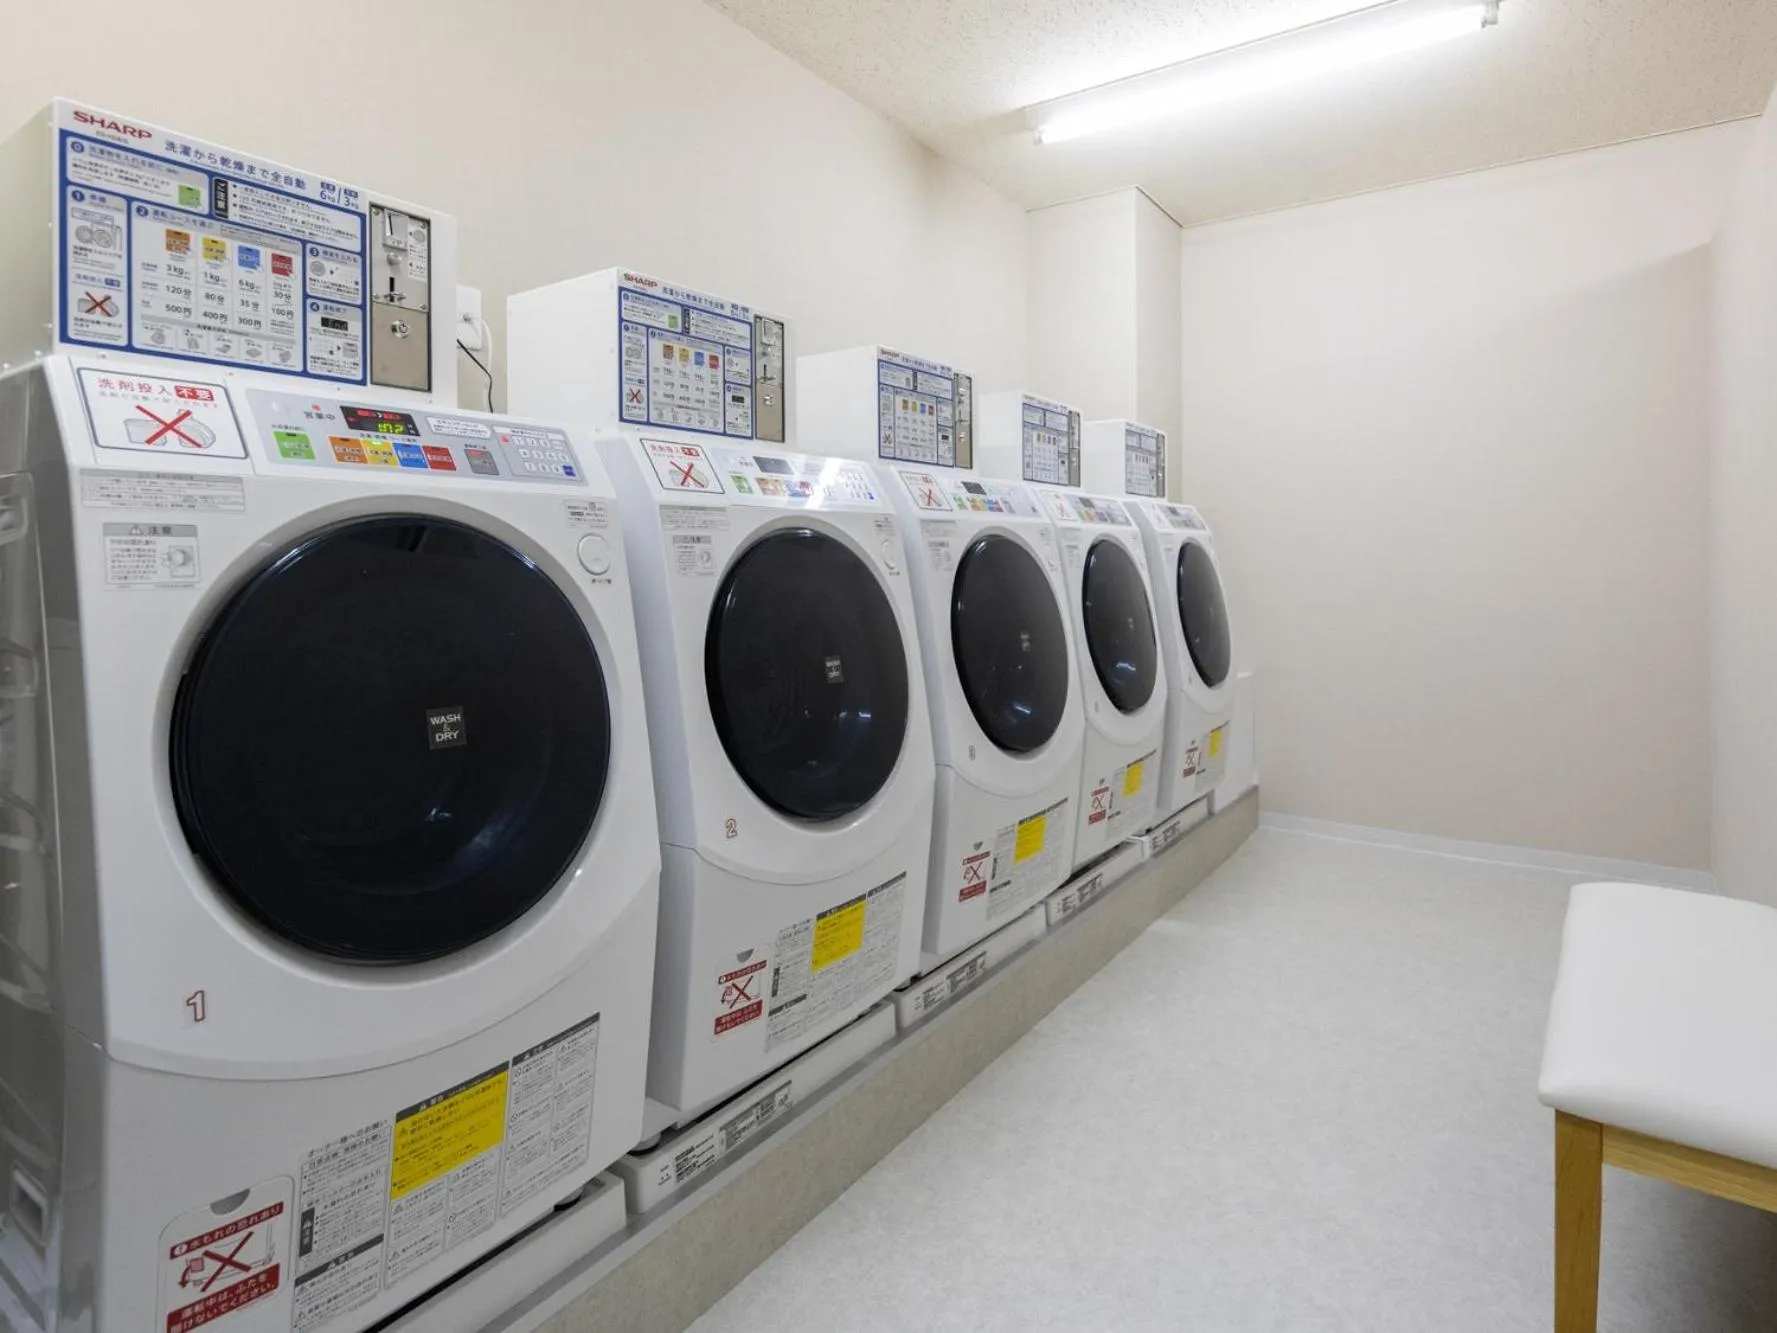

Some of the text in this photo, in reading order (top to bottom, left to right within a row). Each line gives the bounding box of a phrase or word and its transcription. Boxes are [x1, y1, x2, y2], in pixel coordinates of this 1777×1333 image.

[73, 110, 152, 138] SHARP
[164, 140, 306, 190] 洗濯から乾燥まで全自動
[623, 273, 658, 289] SHARP
[98, 378, 172, 395] 洗剤投入
[430, 713, 461, 725] WASH
[436, 731, 459, 742] DRY
[725, 818, 738, 839] 2
[186, 990, 206, 1022] 1
